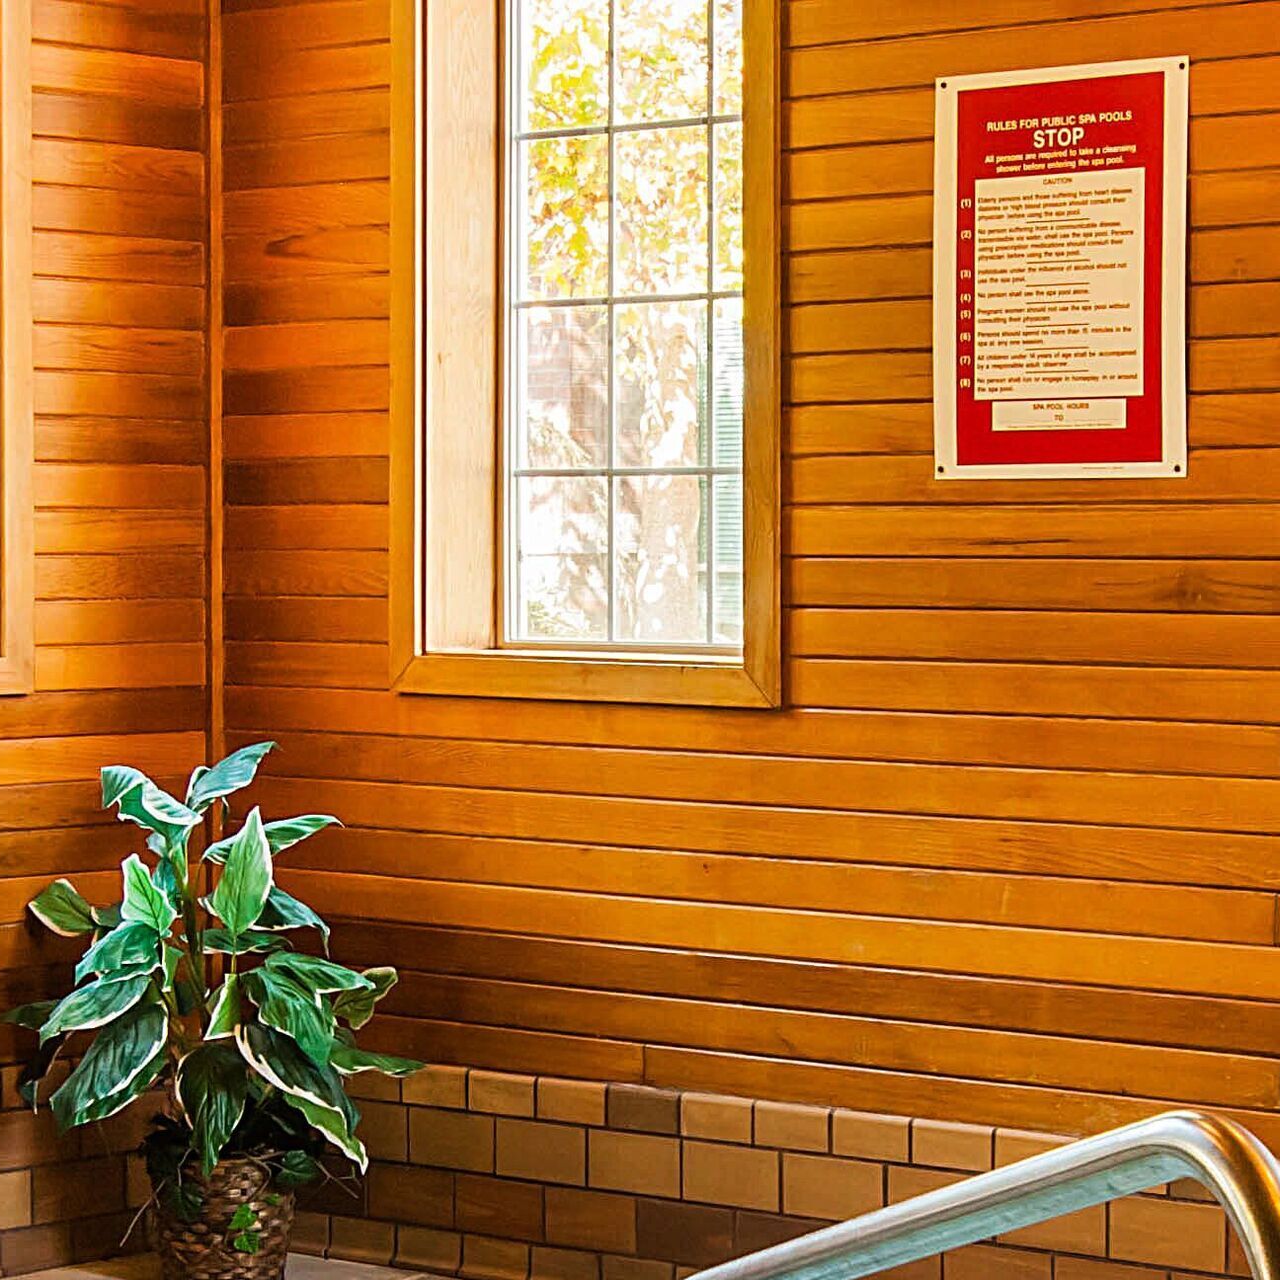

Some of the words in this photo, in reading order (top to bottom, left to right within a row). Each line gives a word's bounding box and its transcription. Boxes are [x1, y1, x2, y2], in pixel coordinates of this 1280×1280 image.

[986, 119, 1017, 132] RULES
[1019, 117, 1039, 129] FOR
[1041, 114, 1075, 127] PUBLIC
[1078, 112, 1096, 124] SPA
[1098, 109, 1132, 123] POOLS
[1033, 125, 1084, 149] STOP
[984, 154, 994, 163] All
[995, 153, 1023, 163] persons
[1024, 152, 1036, 160] are
[1037, 149, 1067, 159] required
[1069, 148, 1076, 156] to
[1078, 147, 1094, 155] take
[1101, 143, 1136, 155] cleansing
[996, 163, 1021, 173] shower
[1022, 161, 1045, 171] before
[1046, 159, 1076, 170] entering
[1077, 158, 1089, 166] the
[1091, 157, 1104, 166] spa
[1105, 155, 1123, 165] pool.
